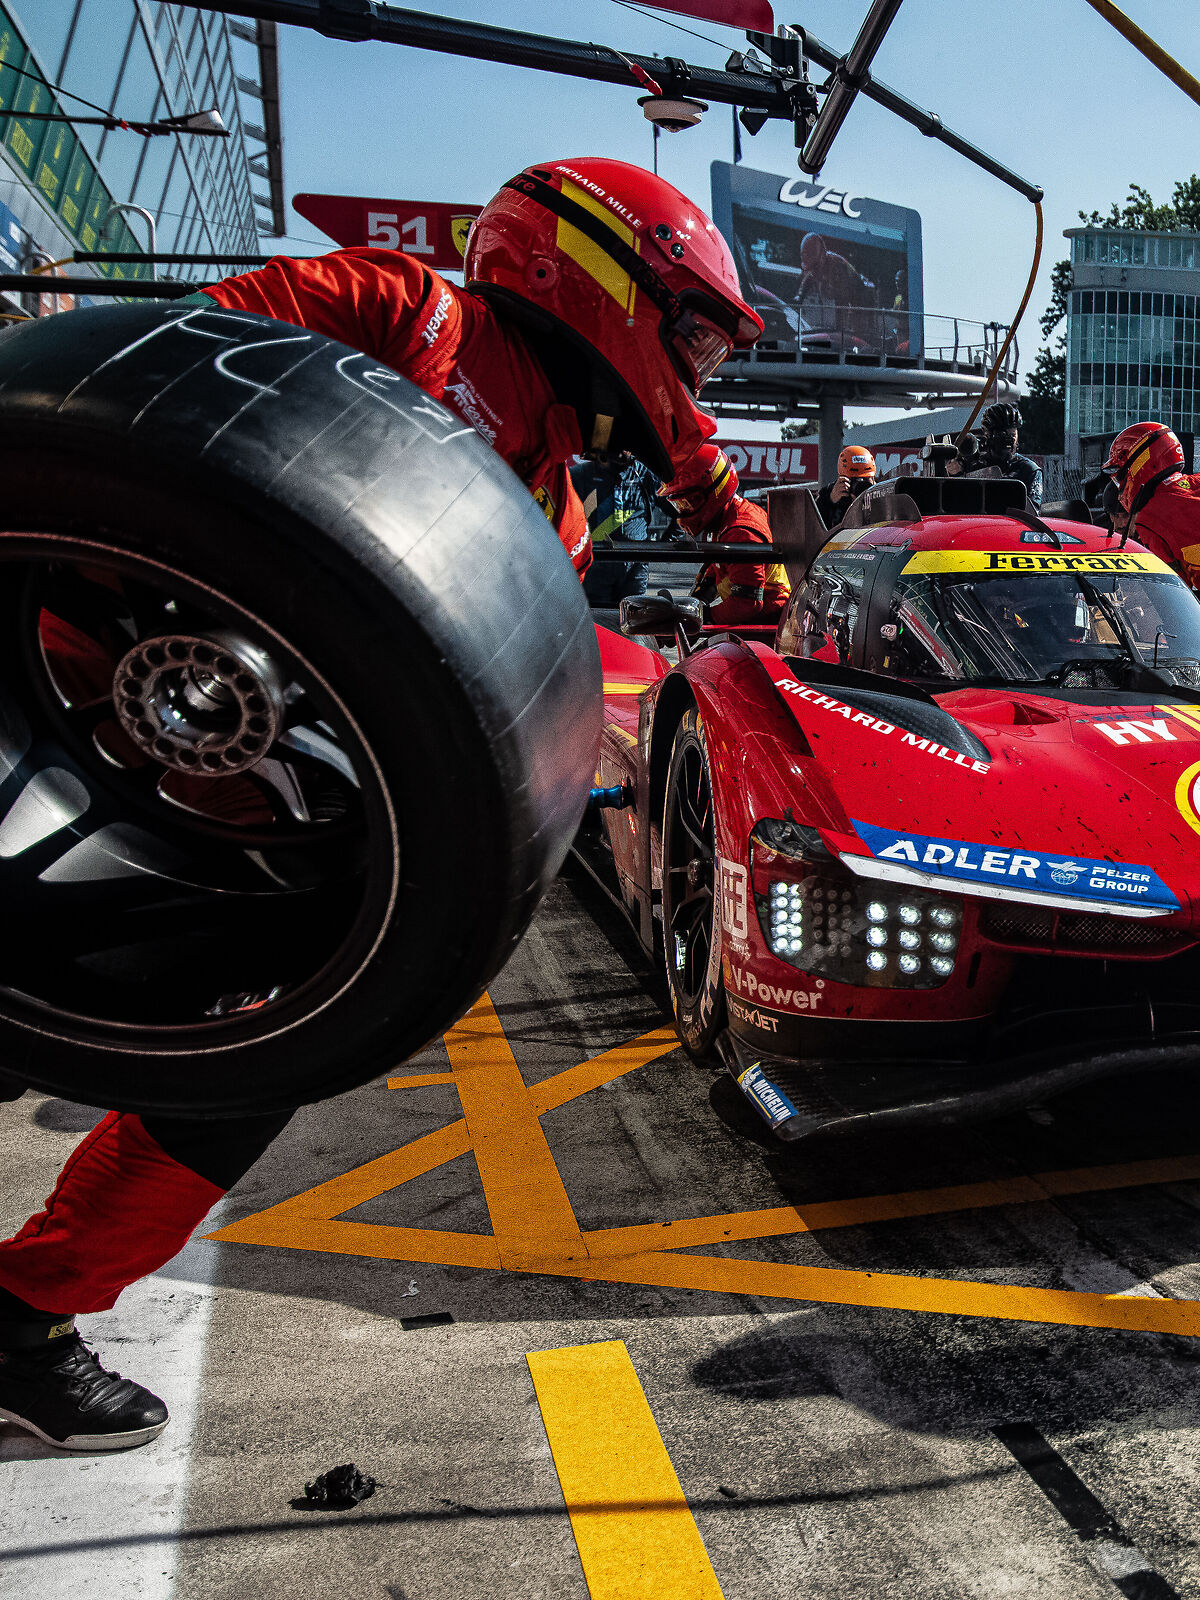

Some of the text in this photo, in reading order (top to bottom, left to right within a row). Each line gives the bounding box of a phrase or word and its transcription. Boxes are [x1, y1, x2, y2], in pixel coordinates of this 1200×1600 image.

[556, 165, 643, 228] RICHARD MILLE
[779, 177, 861, 219] WEC
[367, 211, 435, 254] 51
[421, 286, 453, 348] Sabelt
[723, 444, 807, 476] OTUL
[984, 552, 1148, 571] Ferrari
[774, 678, 991, 775] RICHARD MILLE
[1093, 719, 1178, 745] HY
[877, 839, 1041, 879] ADLER
[731, 964, 823, 1011] V-Power
[752, 1078, 792, 1121] MICHELIN
